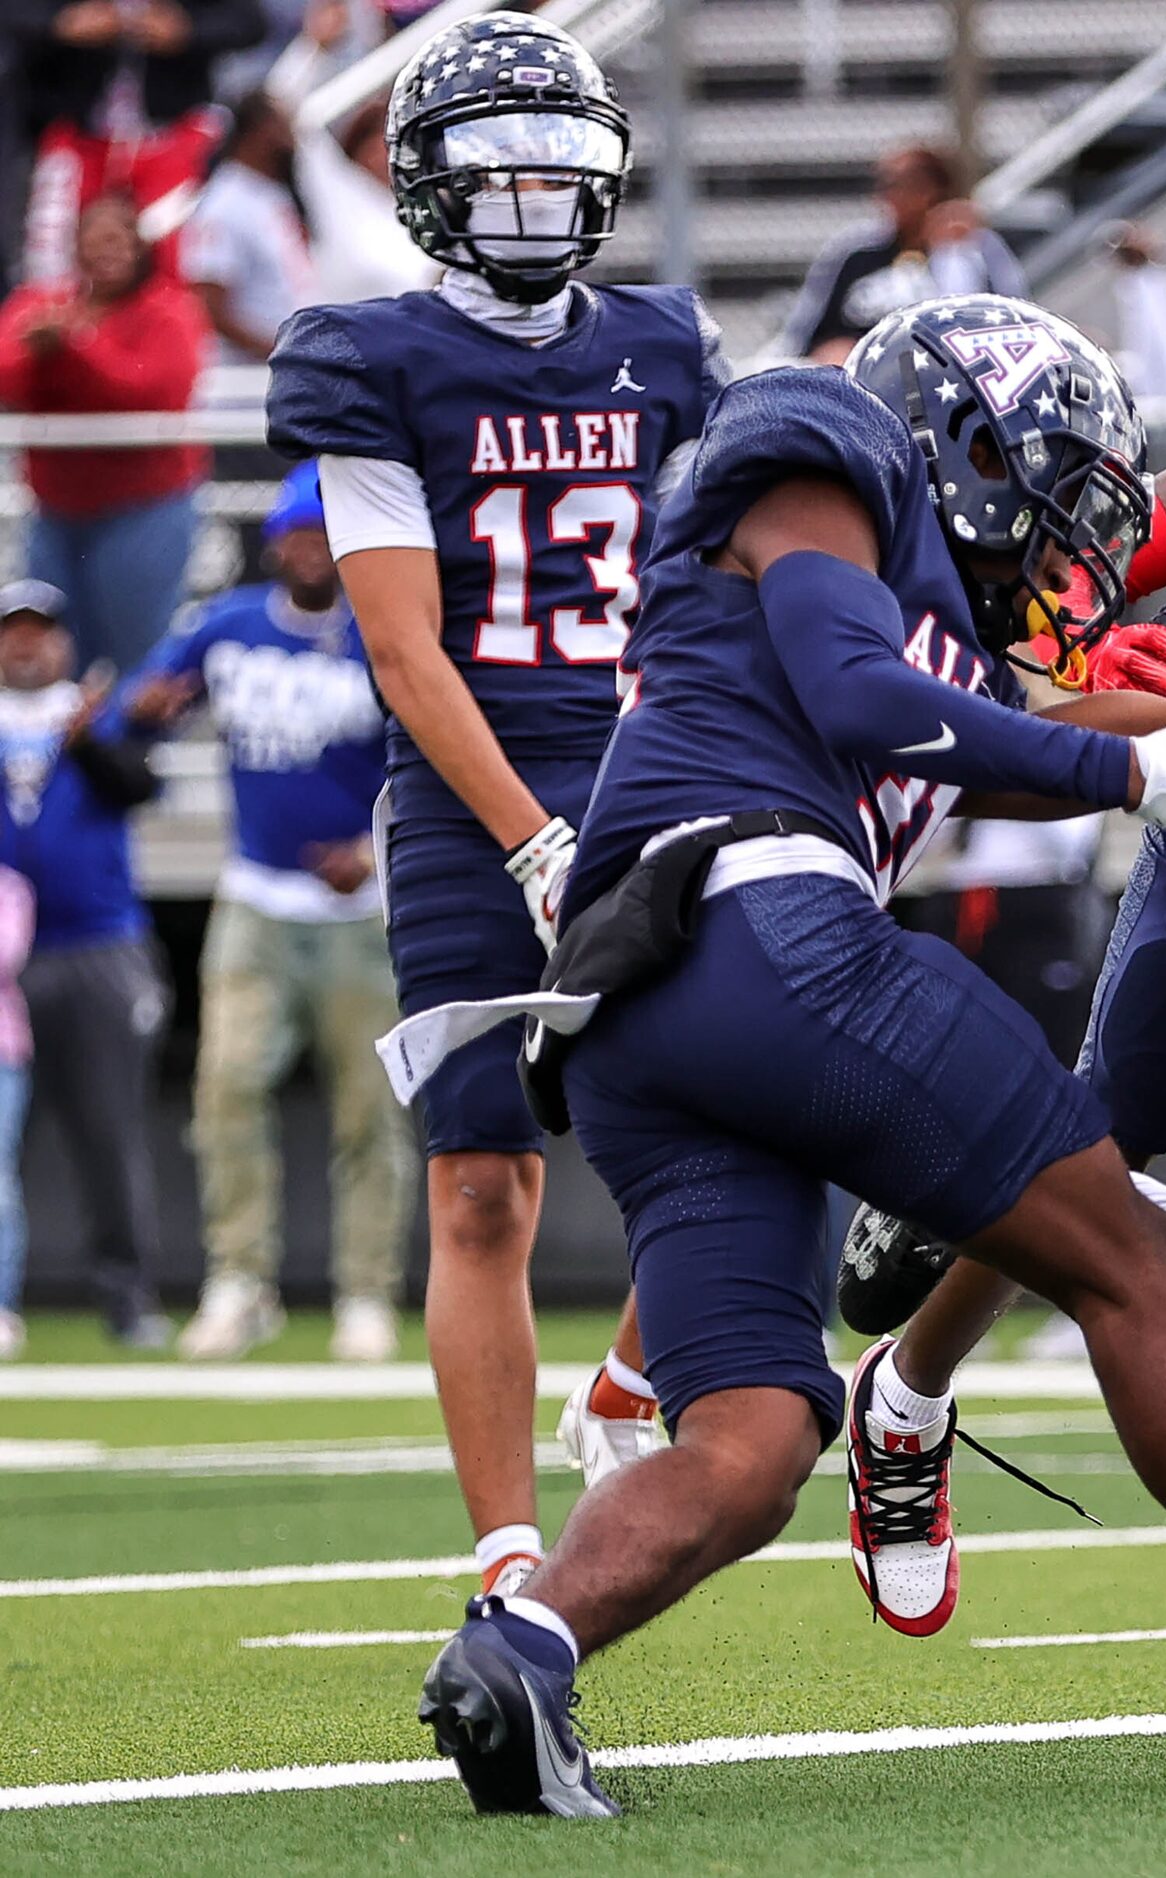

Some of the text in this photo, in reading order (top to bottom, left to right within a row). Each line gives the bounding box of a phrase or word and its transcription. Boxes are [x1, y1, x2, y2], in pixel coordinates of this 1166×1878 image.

[940, 321, 1072, 417] A
[471, 410, 640, 474] ALLEN
[469, 481, 642, 667] 13
